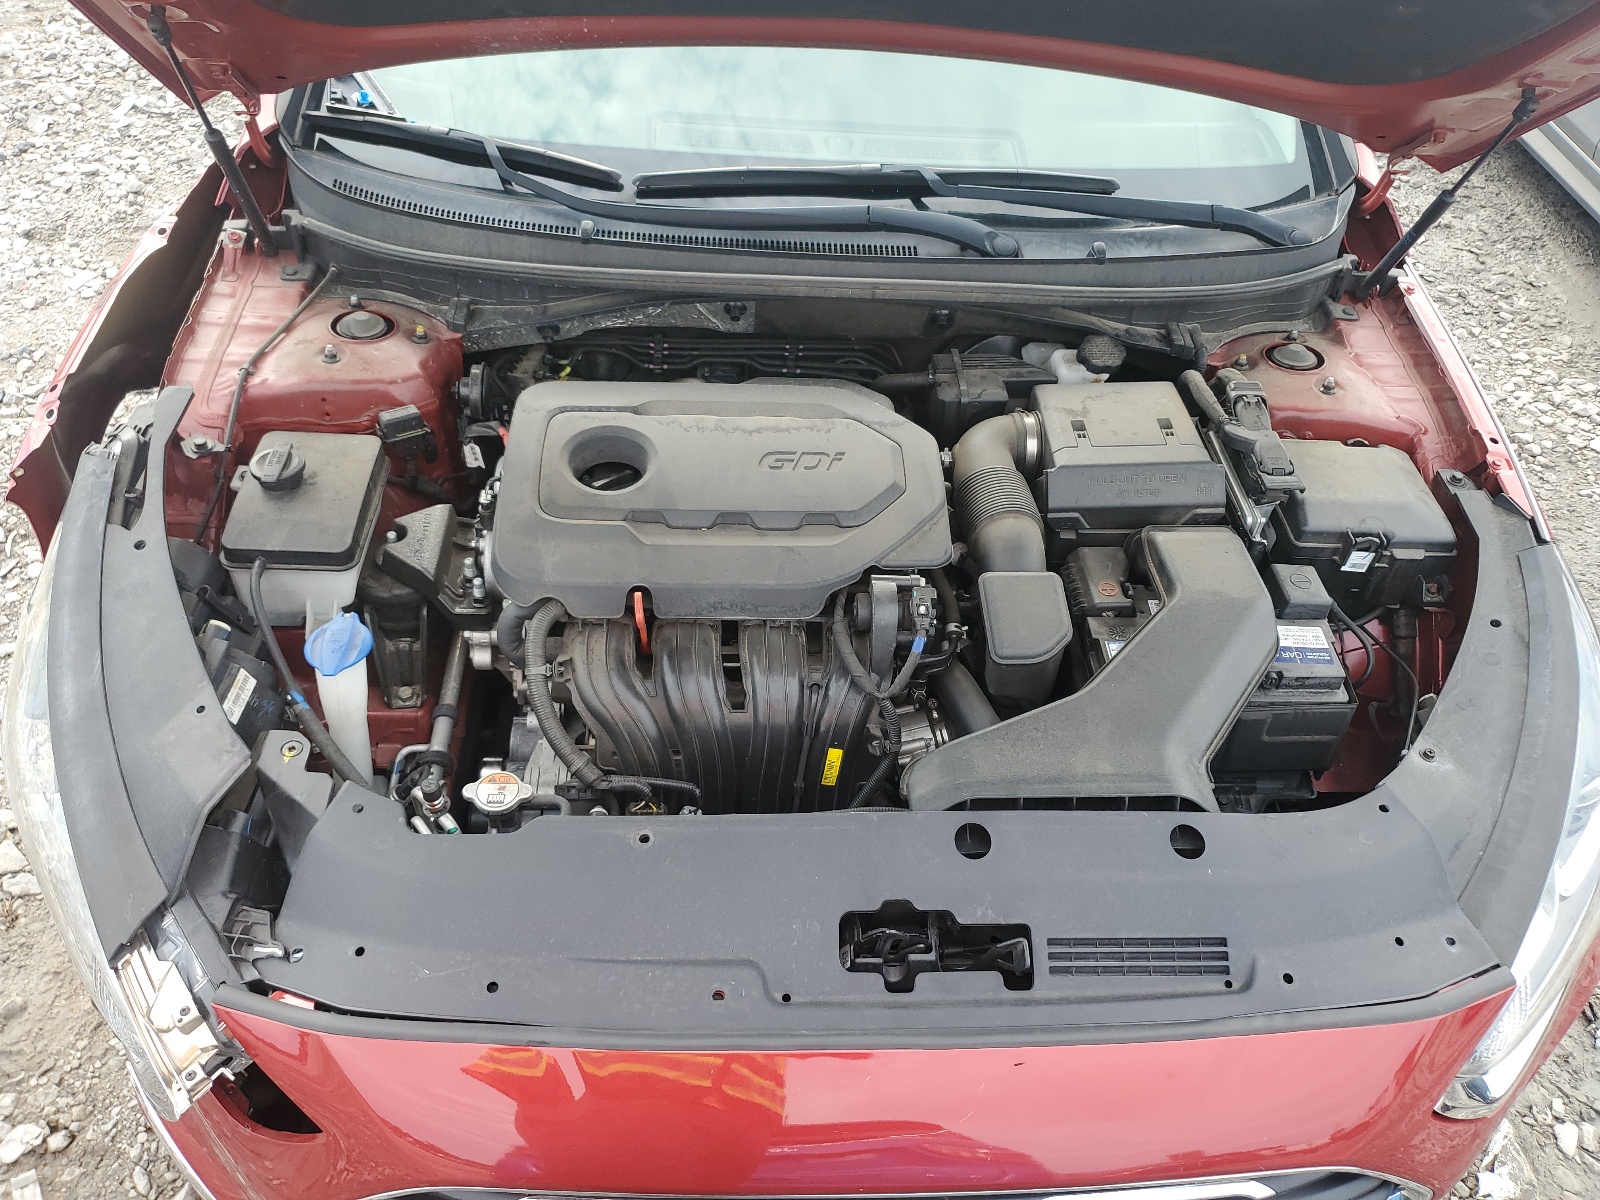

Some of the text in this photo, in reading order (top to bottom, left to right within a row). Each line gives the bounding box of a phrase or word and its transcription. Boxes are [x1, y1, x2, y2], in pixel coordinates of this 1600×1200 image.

[1088, 474, 1186, 486] PULL OUT TO OPEN
[1116, 488, 1160, 498] AIR FILTER
